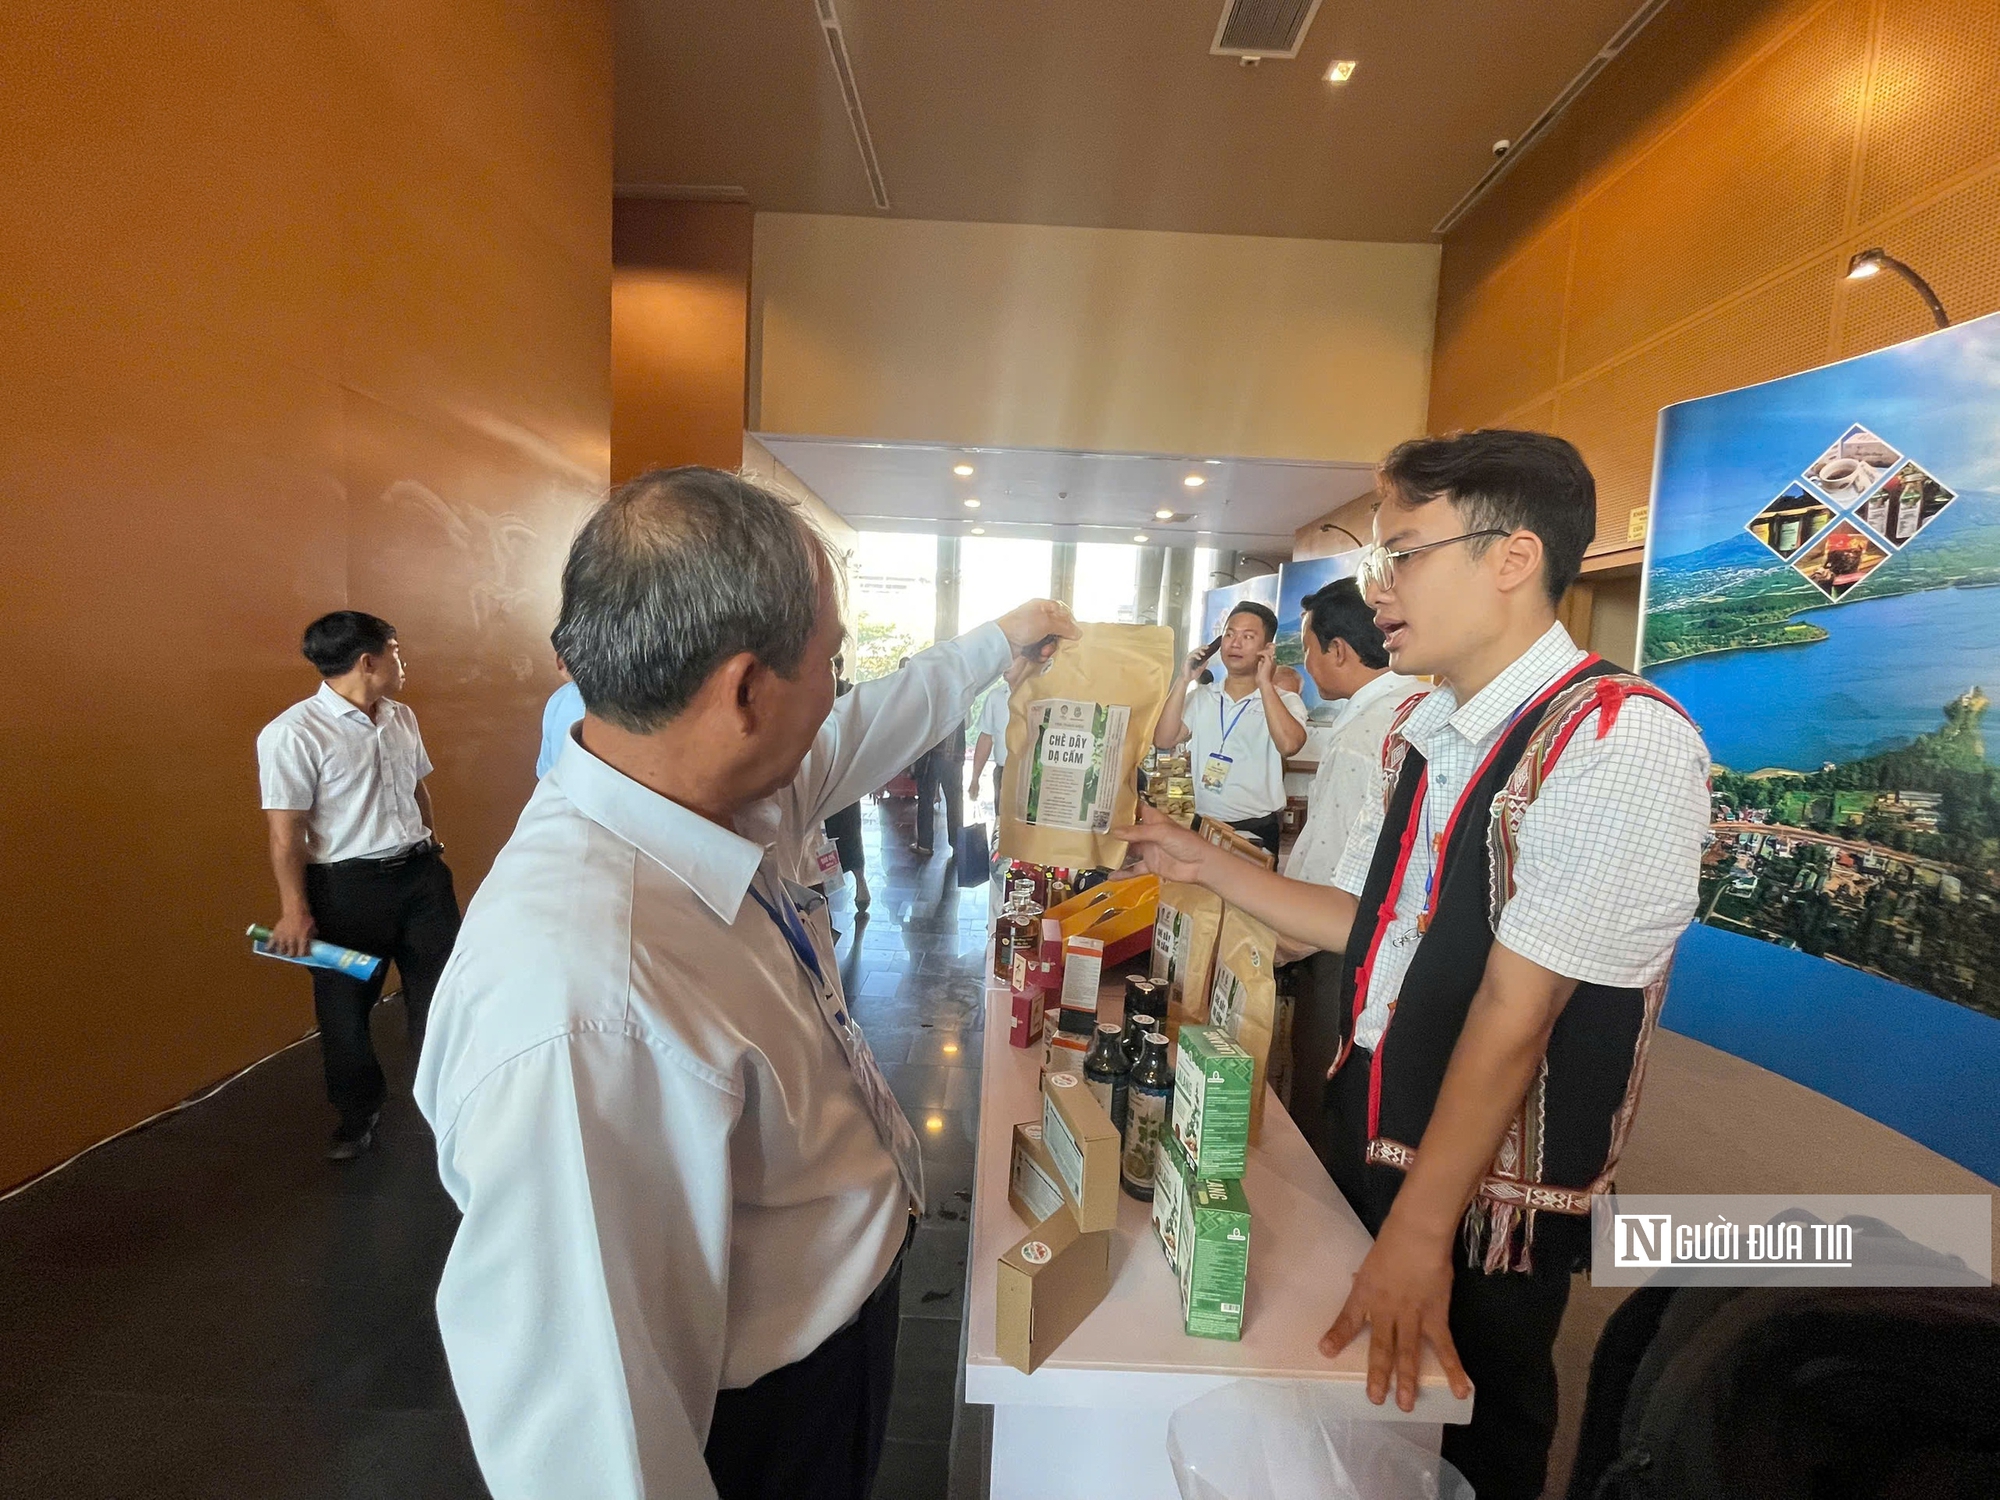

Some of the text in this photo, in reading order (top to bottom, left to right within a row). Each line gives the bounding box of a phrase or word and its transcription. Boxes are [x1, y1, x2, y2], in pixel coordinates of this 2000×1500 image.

[1049, 733, 1087, 749] CHÈ DÂY
[1048, 750, 1060, 764] DẠ
